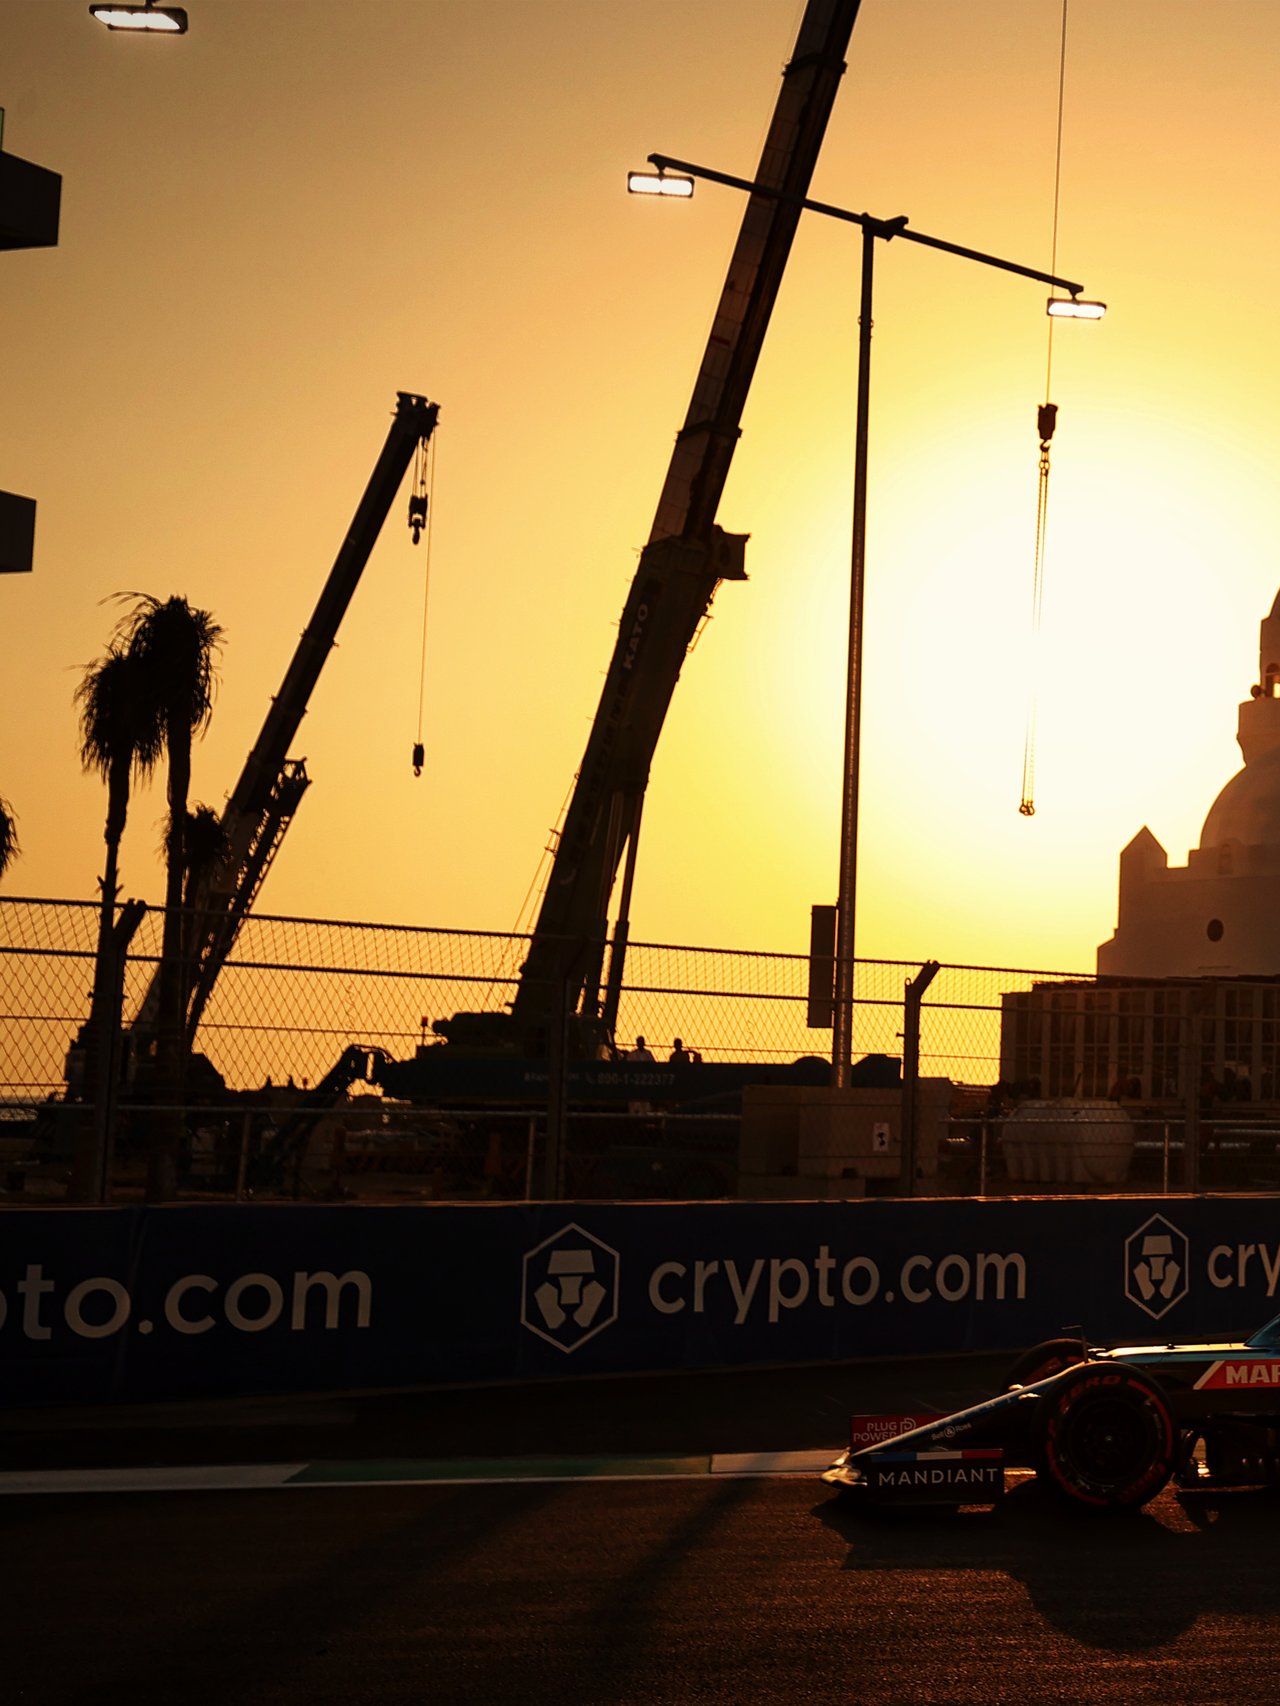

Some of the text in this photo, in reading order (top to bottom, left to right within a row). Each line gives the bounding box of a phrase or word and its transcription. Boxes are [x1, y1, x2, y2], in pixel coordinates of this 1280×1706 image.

[623, 603, 649, 670] KATO
[0, 1263, 374, 1341] to.com
[648, 1244, 1027, 1326] crypto.com
[867, 1421, 898, 1432] PLUG
[878, 1468, 998, 1487] MANDIANT
